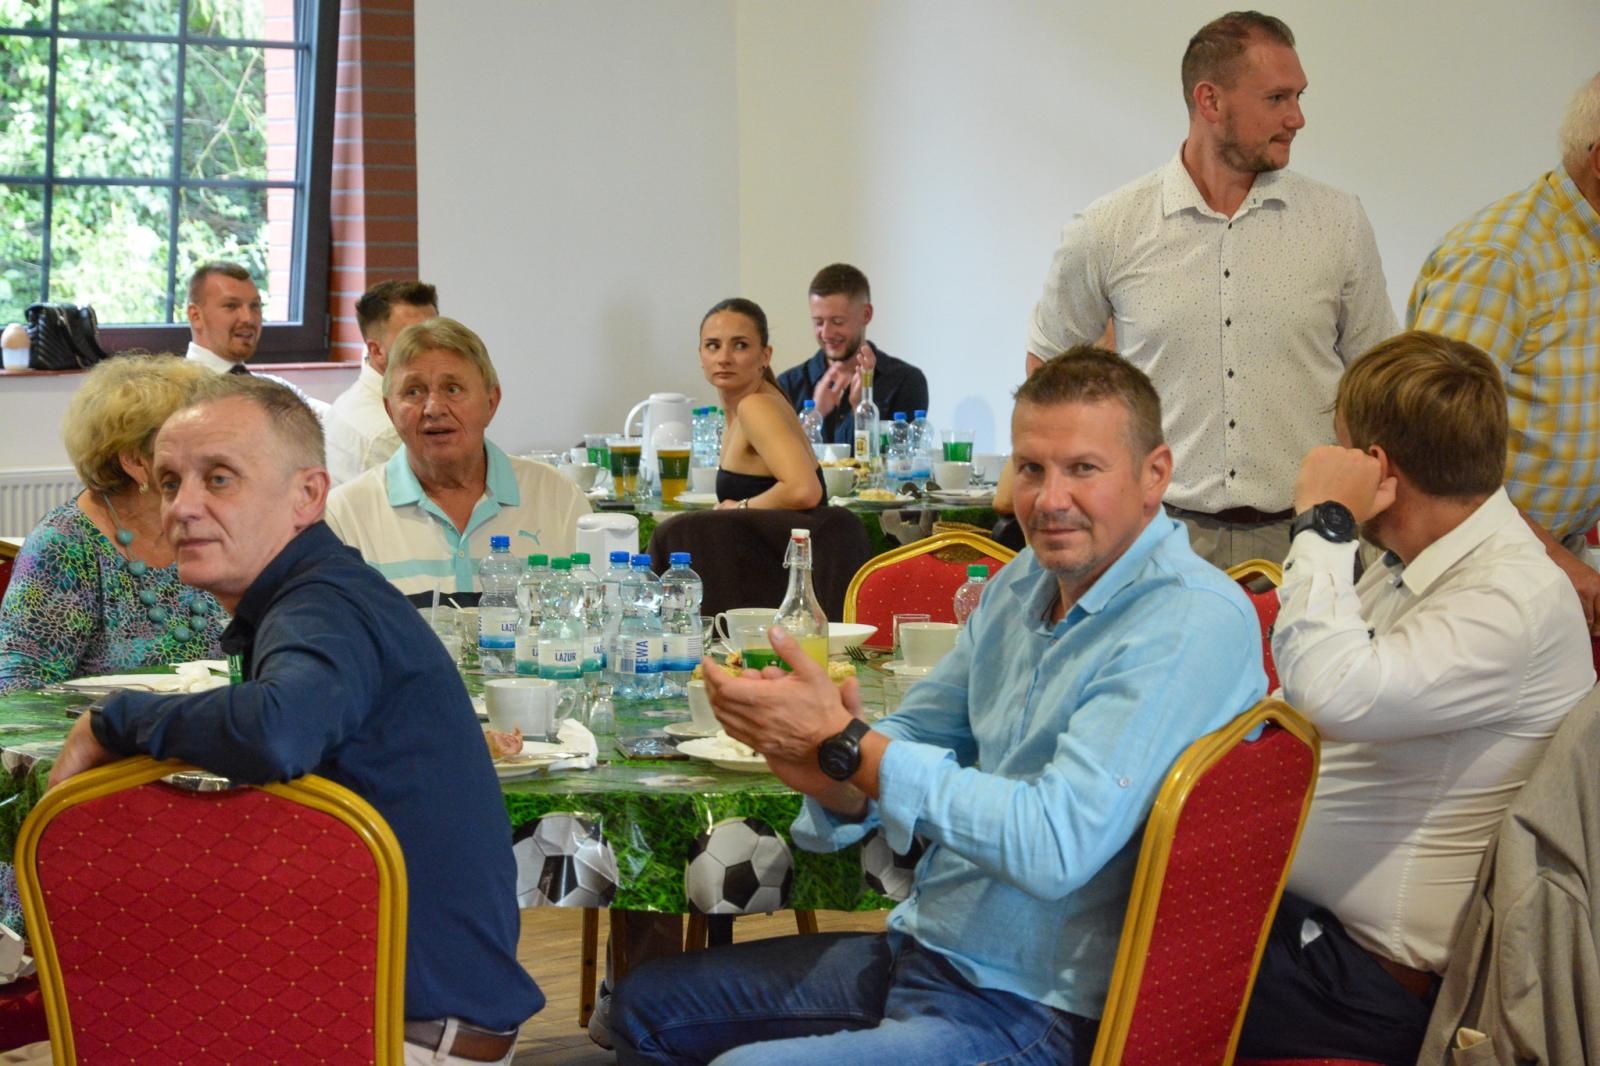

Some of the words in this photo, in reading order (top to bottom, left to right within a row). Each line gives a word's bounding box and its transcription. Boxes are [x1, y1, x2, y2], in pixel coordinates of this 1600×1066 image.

[501, 623, 516, 632] LAZU
[555, 652, 577, 662] LAZUR
[635, 640, 649, 671] BEWA
